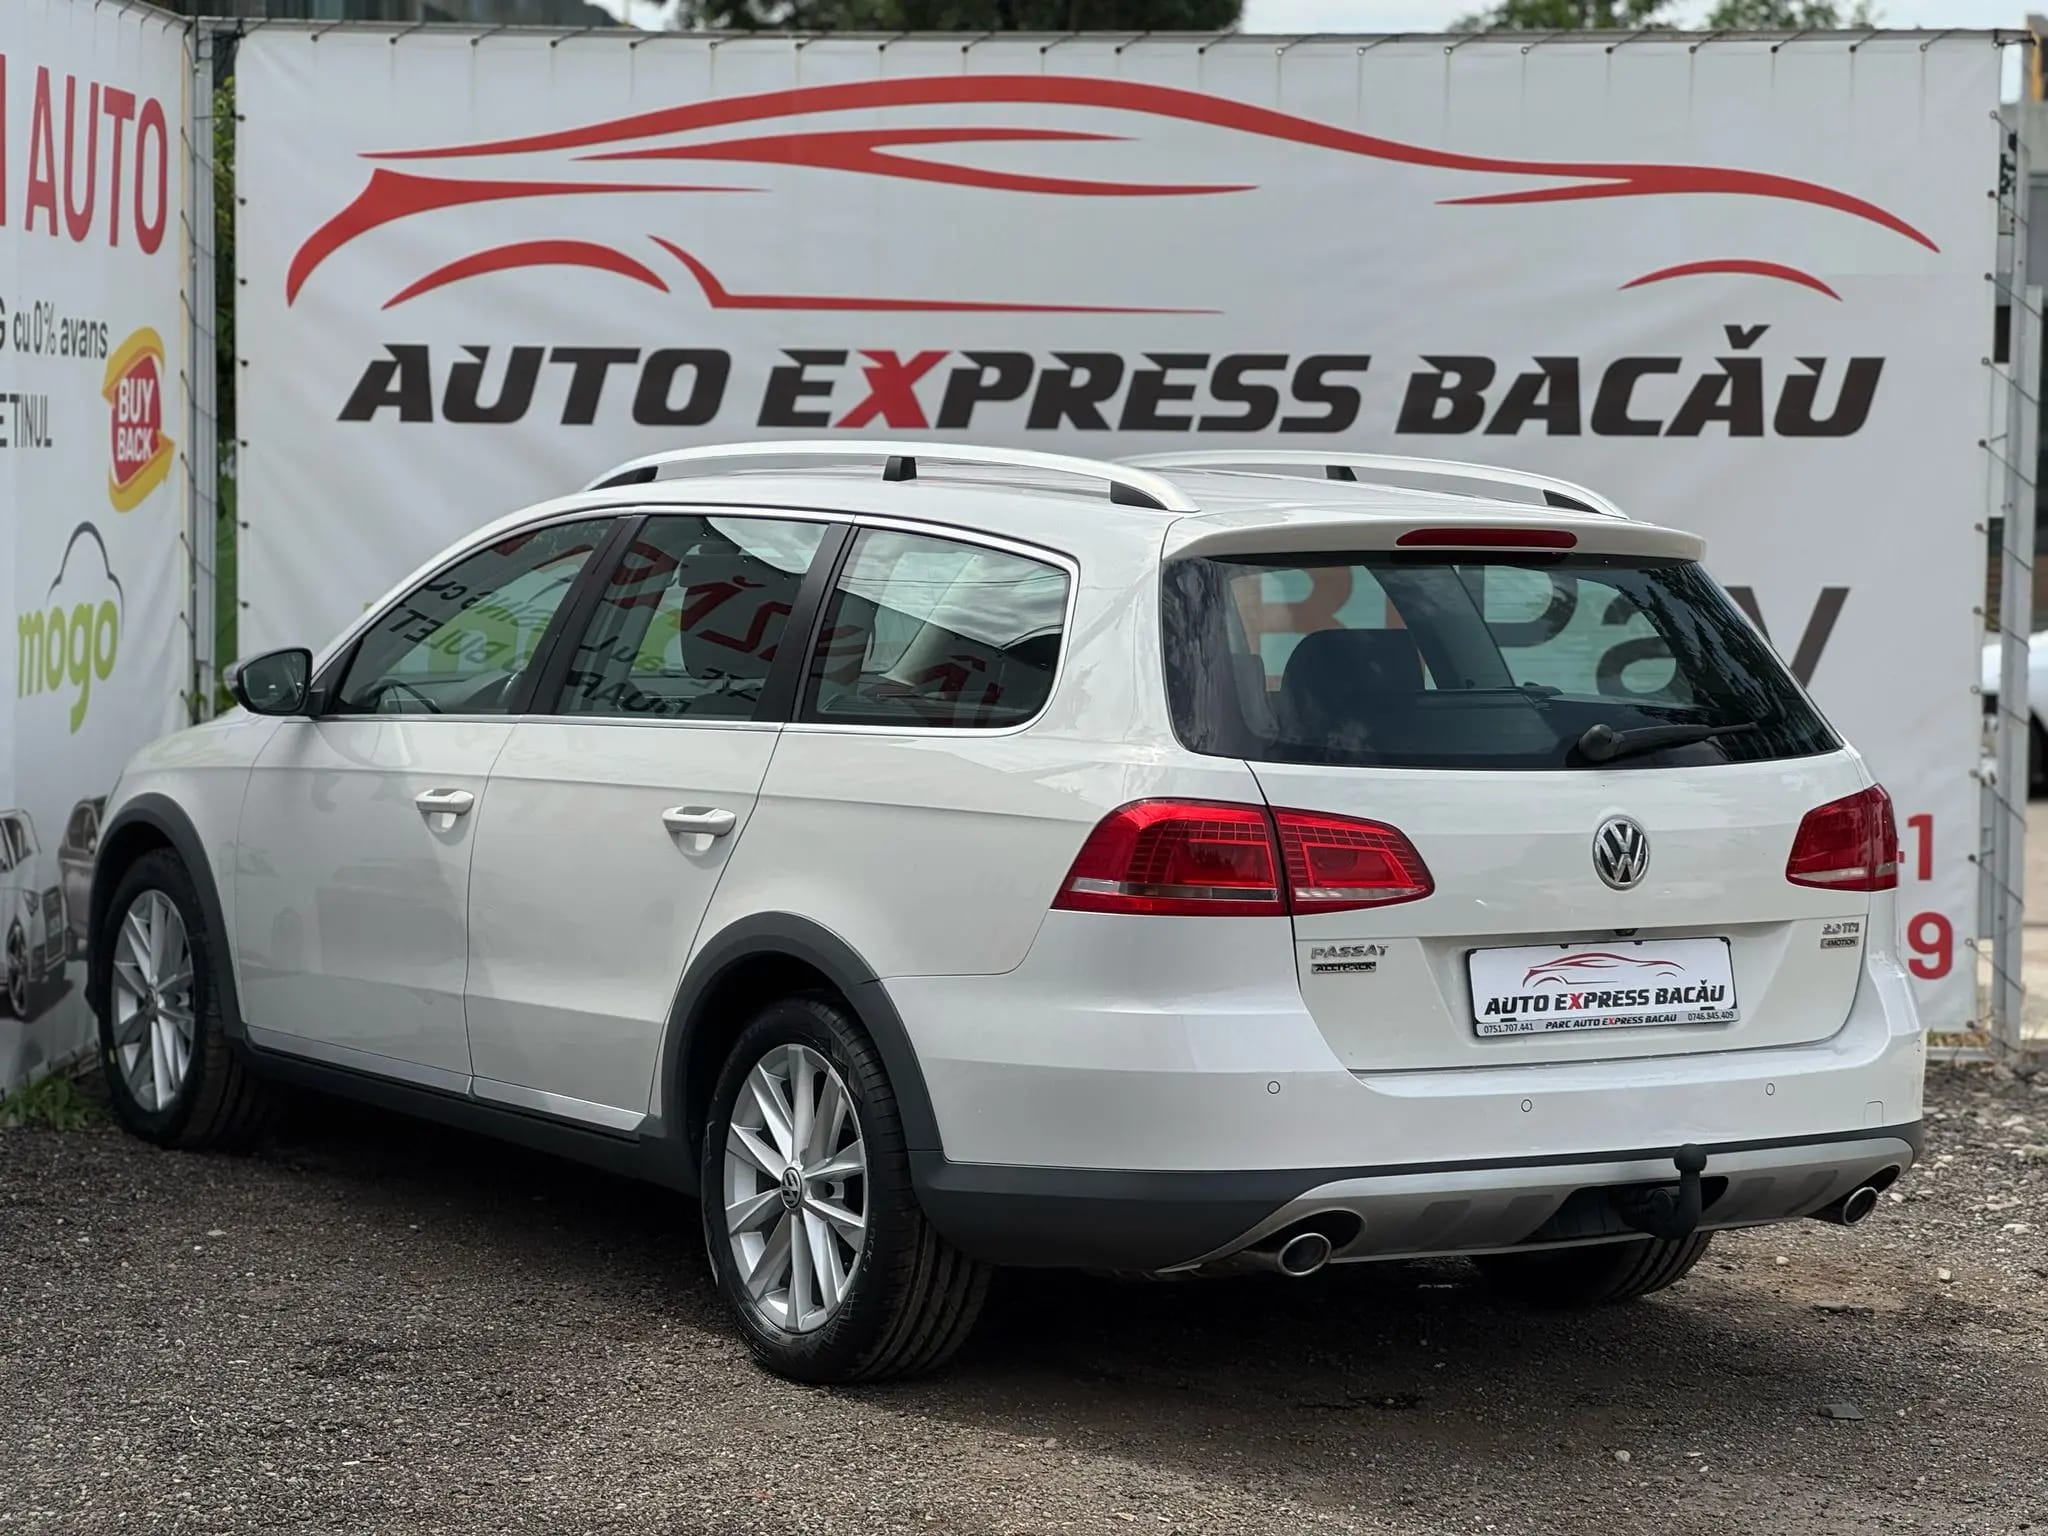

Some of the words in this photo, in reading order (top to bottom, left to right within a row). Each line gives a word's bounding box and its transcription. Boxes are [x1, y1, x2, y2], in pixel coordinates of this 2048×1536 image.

[24, 65, 168, 256] AUTO
[34, 300, 56, 356] 0%
[60, 317, 109, 360] avans
[118, 378, 155, 424] BUY
[337, 344, 732, 426] AUTO
[756, 348, 1372, 433] EXPRESS
[1395, 324, 1887, 438] BACĂU
[117, 427, 153, 462] BACK
[17, 599, 119, 736] mogo
[1311, 944, 1389, 959] PASSAT
[1484, 993, 1550, 1016] AUTO
[1554, 988, 1650, 1011] EXPRESS
[1654, 979, 1725, 1007] BACĂU
[1545, 1020, 1572, 1030] PARC
[1573, 1018, 1600, 1028] AUTO
[1602, 1015, 1644, 1026] EXPRESS
